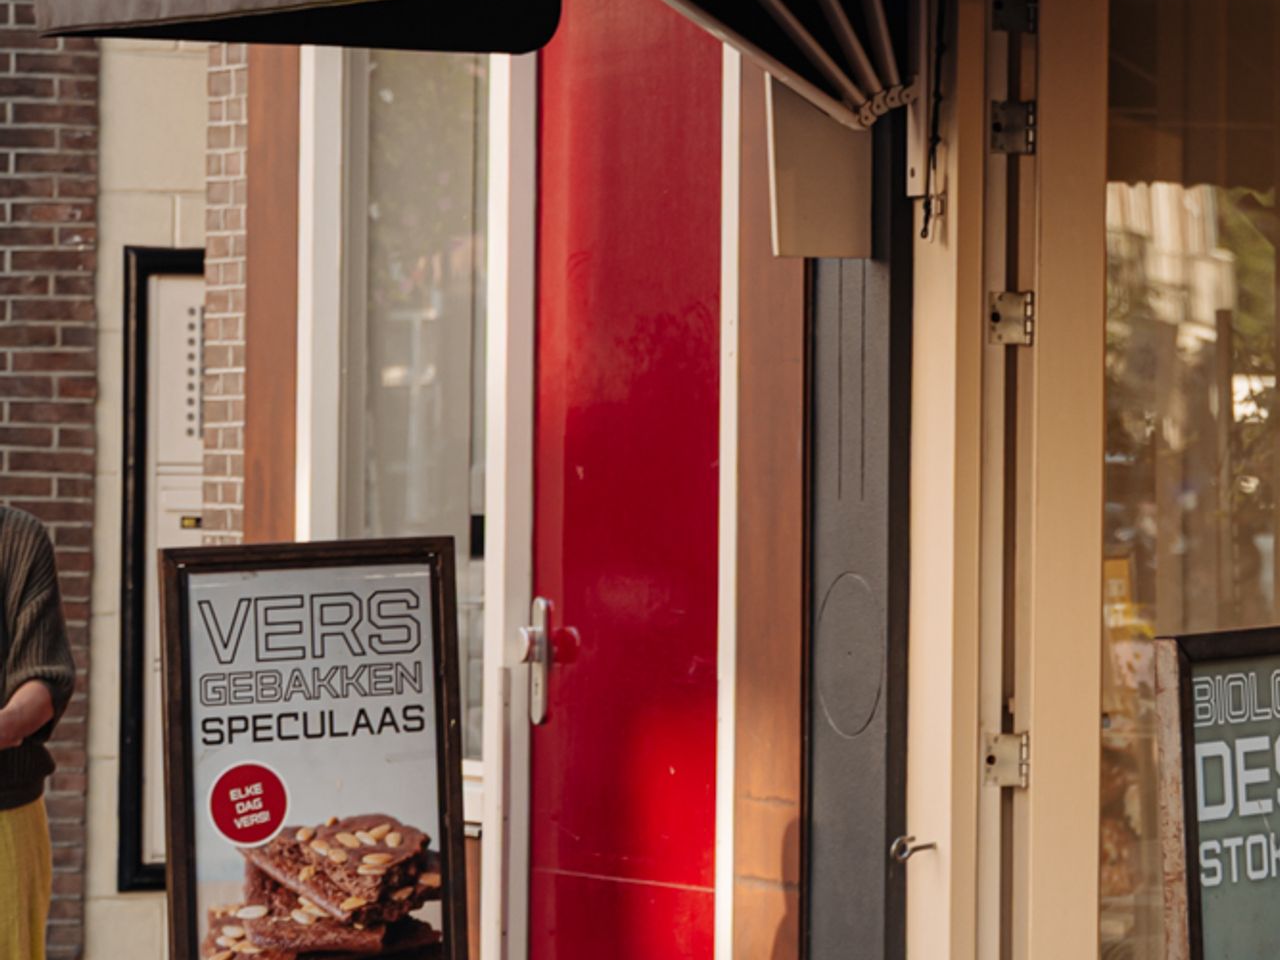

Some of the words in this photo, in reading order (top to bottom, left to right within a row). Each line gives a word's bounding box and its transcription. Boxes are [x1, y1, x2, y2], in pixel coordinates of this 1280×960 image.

[198, 589, 423, 665] VERS
[199, 661, 424, 706] GEBAKKEN
[201, 704, 426, 746] SPECULAAS
[229, 782, 264, 801] ELKE
[235, 797, 263, 815] DAG
[233, 810, 271, 829] VERS!
